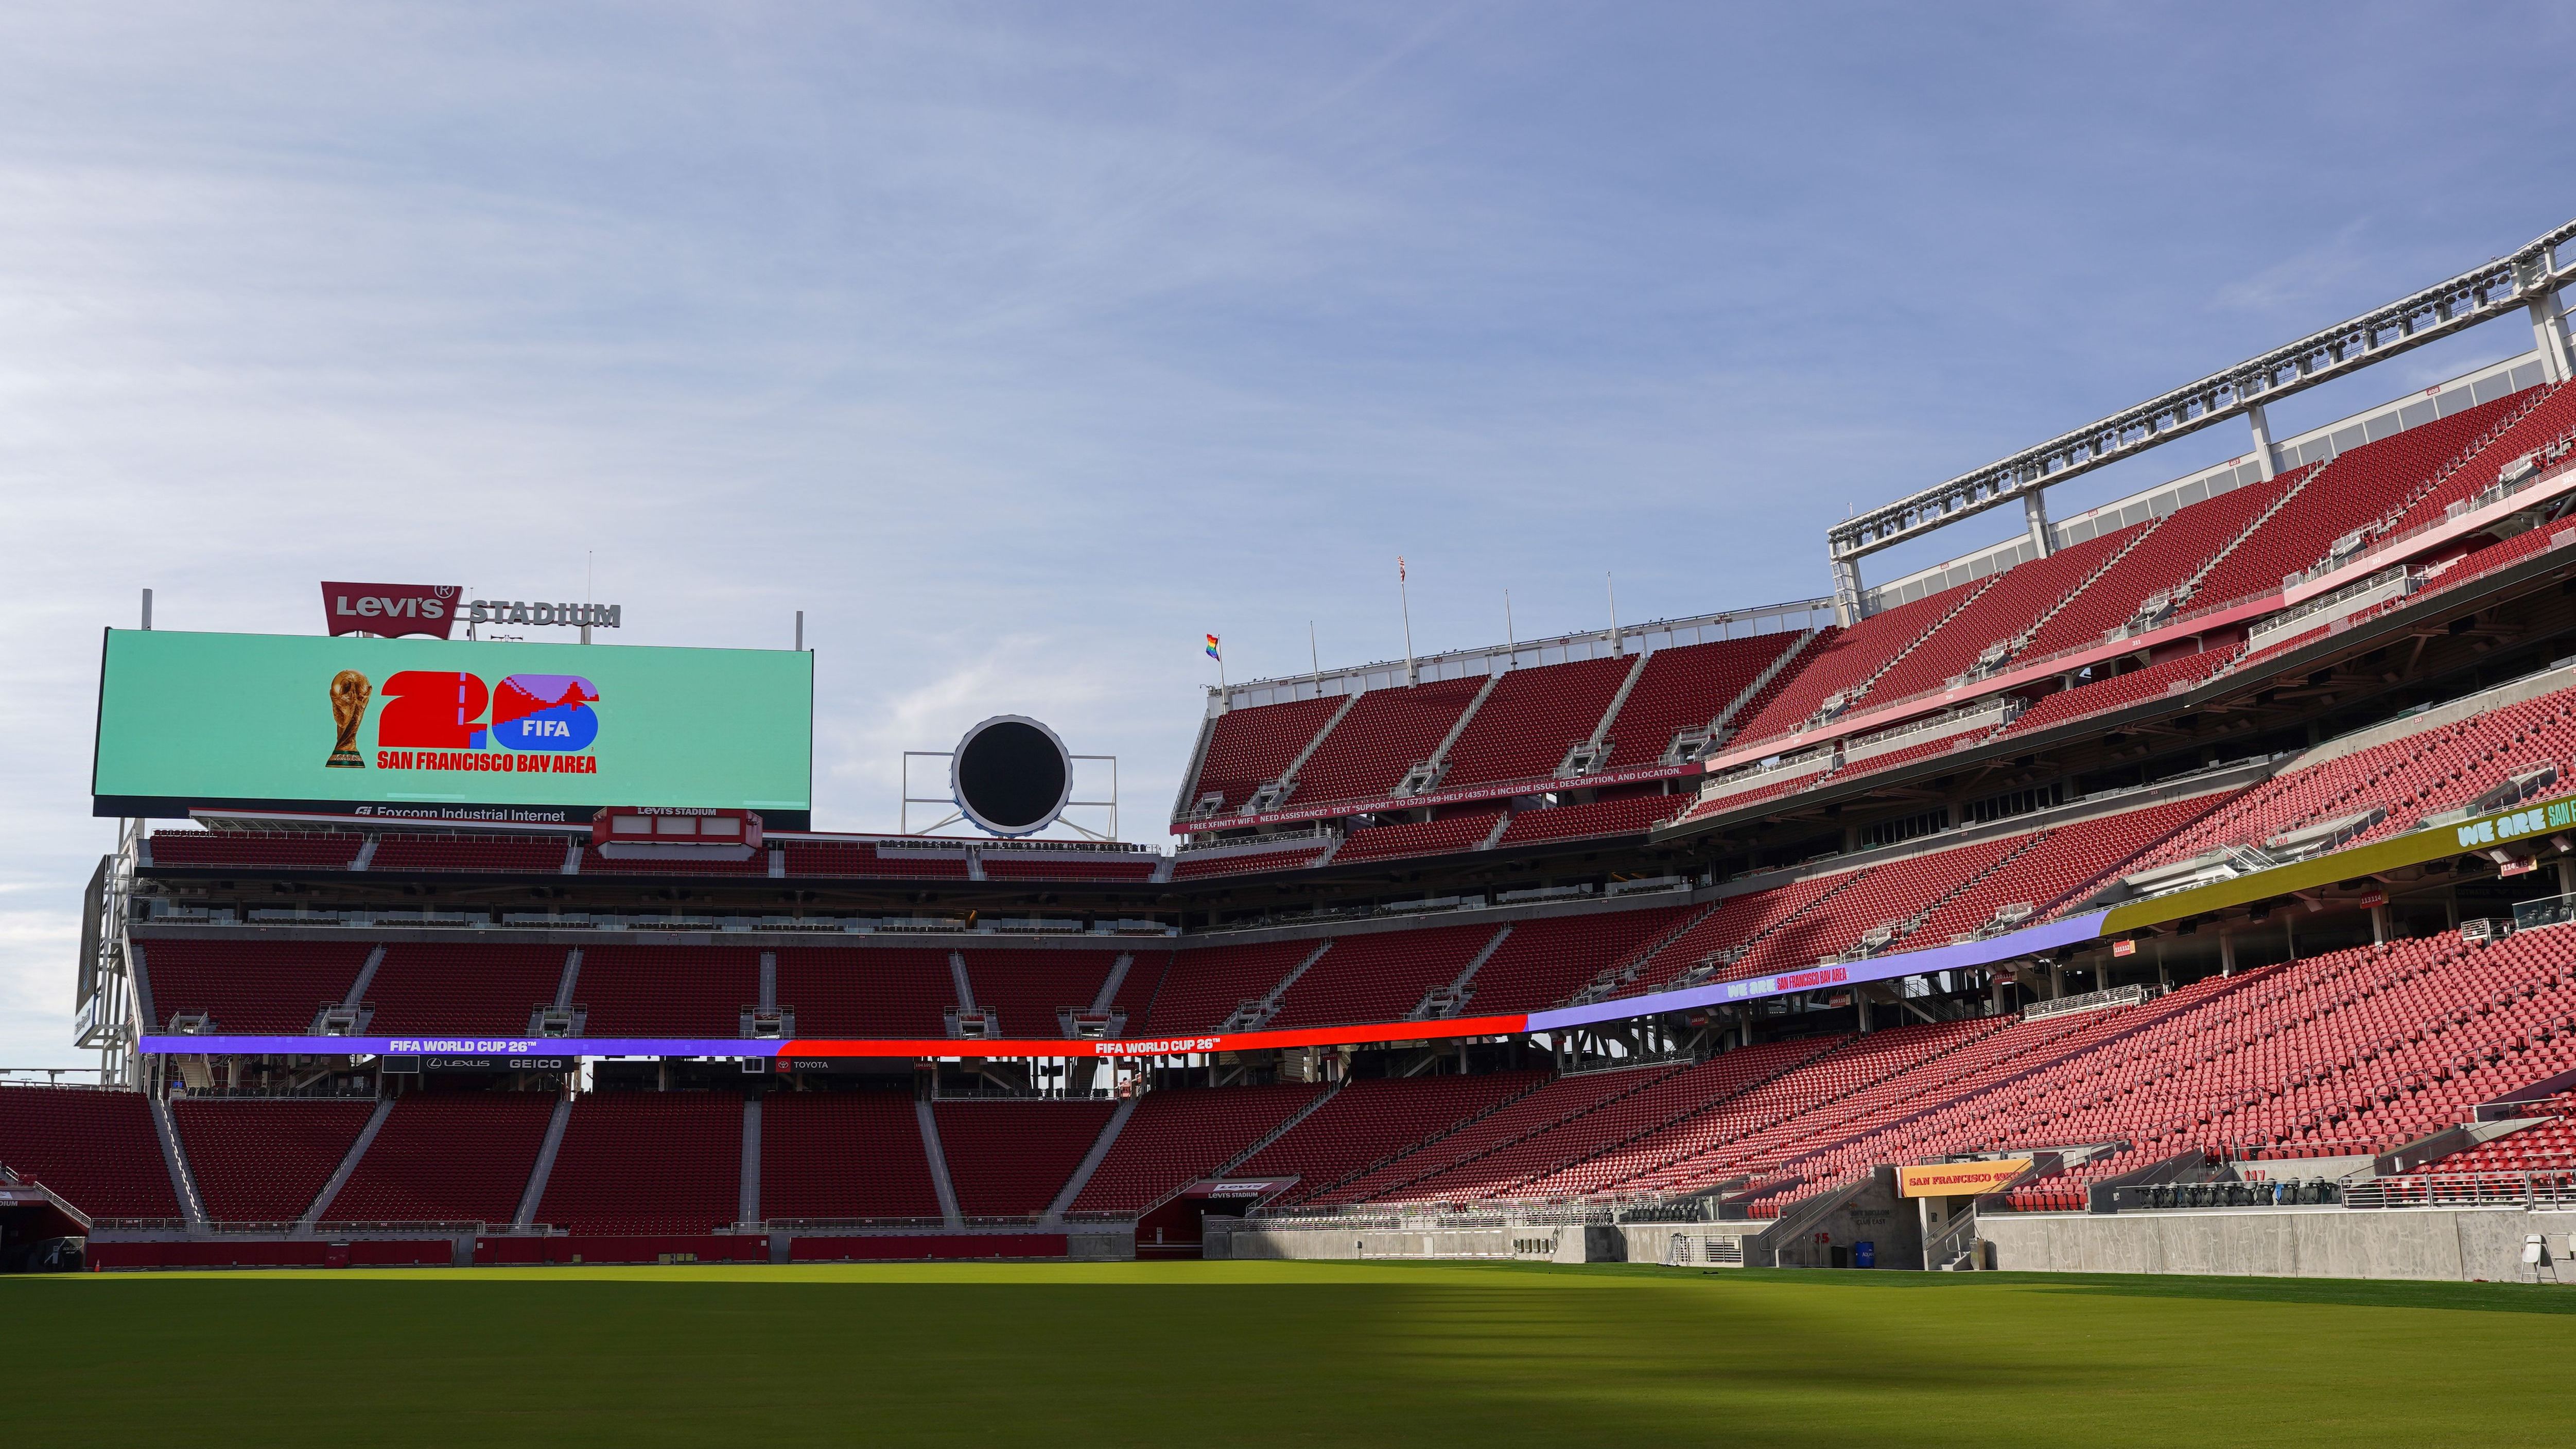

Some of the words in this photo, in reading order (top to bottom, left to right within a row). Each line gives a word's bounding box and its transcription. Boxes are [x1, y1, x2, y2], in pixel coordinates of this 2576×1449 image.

[2428, 387, 2439, 395] 408
[2562, 475, 2574, 484] 313
[469, 600, 621, 628] STADIUM
[523, 720, 570, 737] FIFA
[377, 750, 412, 770] SAN
[416, 752, 513, 772] FRANCISCO
[517, 754, 550, 773] BAY
[552, 755, 597, 774] AREA
[1190, 822, 1207, 830] FREE
[1208, 819, 1235, 829] XFINITY
[1238, 817, 1255, 826] WIFI.
[1260, 814, 1279, 823] NEED
[1281, 809, 1327, 821] ASSISTANCE?
[1332, 806, 1351, 814] TEXT
[1407, 797, 1425, 806] (573)
[1427, 793, 1463, 803] 549-HELP
[1465, 789, 1489, 799] (4357)
[1498, 785, 1531, 795] INCLUDE
[1533, 782, 1558, 792] ISSUE,
[1560, 775, 1616, 788] DESCRIPTION,
[1617, 773, 1635, 781] AND
[1637, 767, 1682, 778] LOCATION.
[377, 806, 438, 817] Foxconn
[442, 808, 507, 820] Industrial
[512, 810, 565, 822] Internet
[675, 808, 716, 816] STADIUM
[2457, 820, 2495, 847] WE
[2548, 802, 2571, 827] SAN
[2275, 836, 2288, 846] 214
[2503, 863, 2515, 871] 114
[1727, 983, 1748, 998] WE
[1777, 976, 1788, 991] SAN
[1789, 972, 1818, 989] FRANCISCO
[1820, 970, 1831, 983] BAY
[1832, 967, 1847, 982] AREA
[390, 1040, 421, 1052] FIFA
[423, 1040, 475, 1052] WORLD
[477, 1041, 507, 1052] CUP
[1095, 1043, 1124, 1054] FIFA
[1125, 1041, 1169, 1053] WORLD
[1171, 1040, 1195, 1052] CUP
[510, 1059, 562, 1069] GEICO
[1909, 1177, 1930, 1186] SAN
[1932, 1174, 1991, 1185] FRANCISCO
[2244, 1169, 2265, 1182] 117
